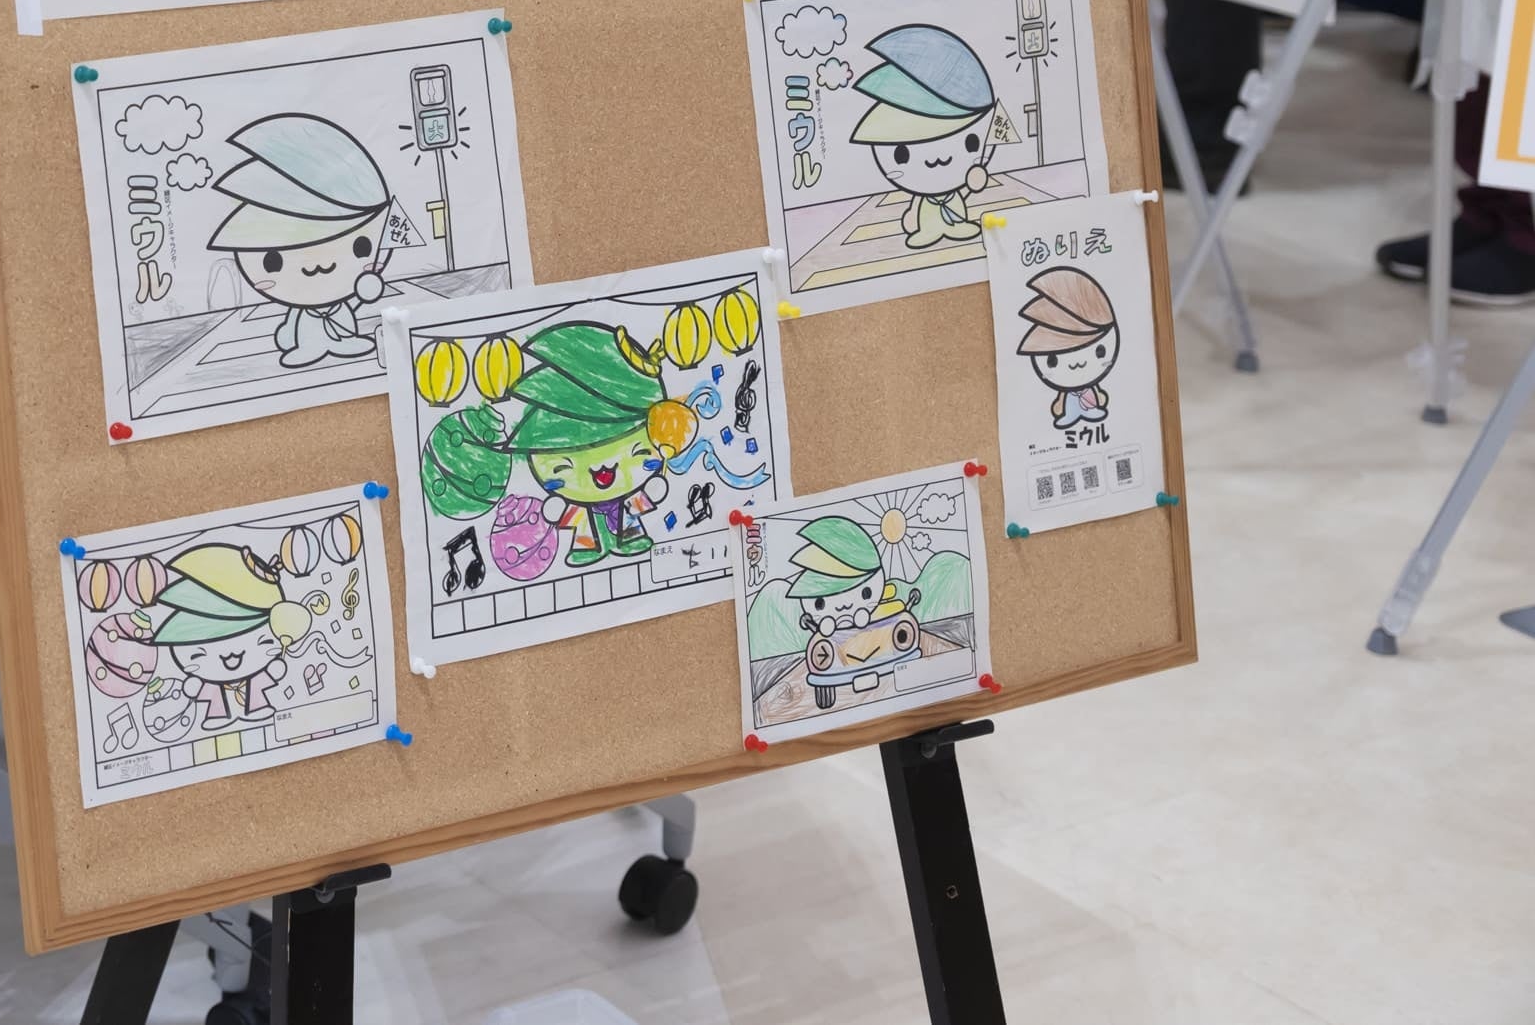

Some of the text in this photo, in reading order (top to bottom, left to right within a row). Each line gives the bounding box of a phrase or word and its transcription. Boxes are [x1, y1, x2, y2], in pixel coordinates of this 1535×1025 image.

[785, 75, 822, 190] ミウル
[994, 115, 1010, 130] あん
[389, 215, 410, 231] あん
[390, 229, 411, 246] ぜん
[127, 175, 173, 304] ミウル
[1021, 228, 1113, 267] ぬりえ
[1064, 423, 1111, 449] ミウル
[746, 523, 766, 588] ミウル
